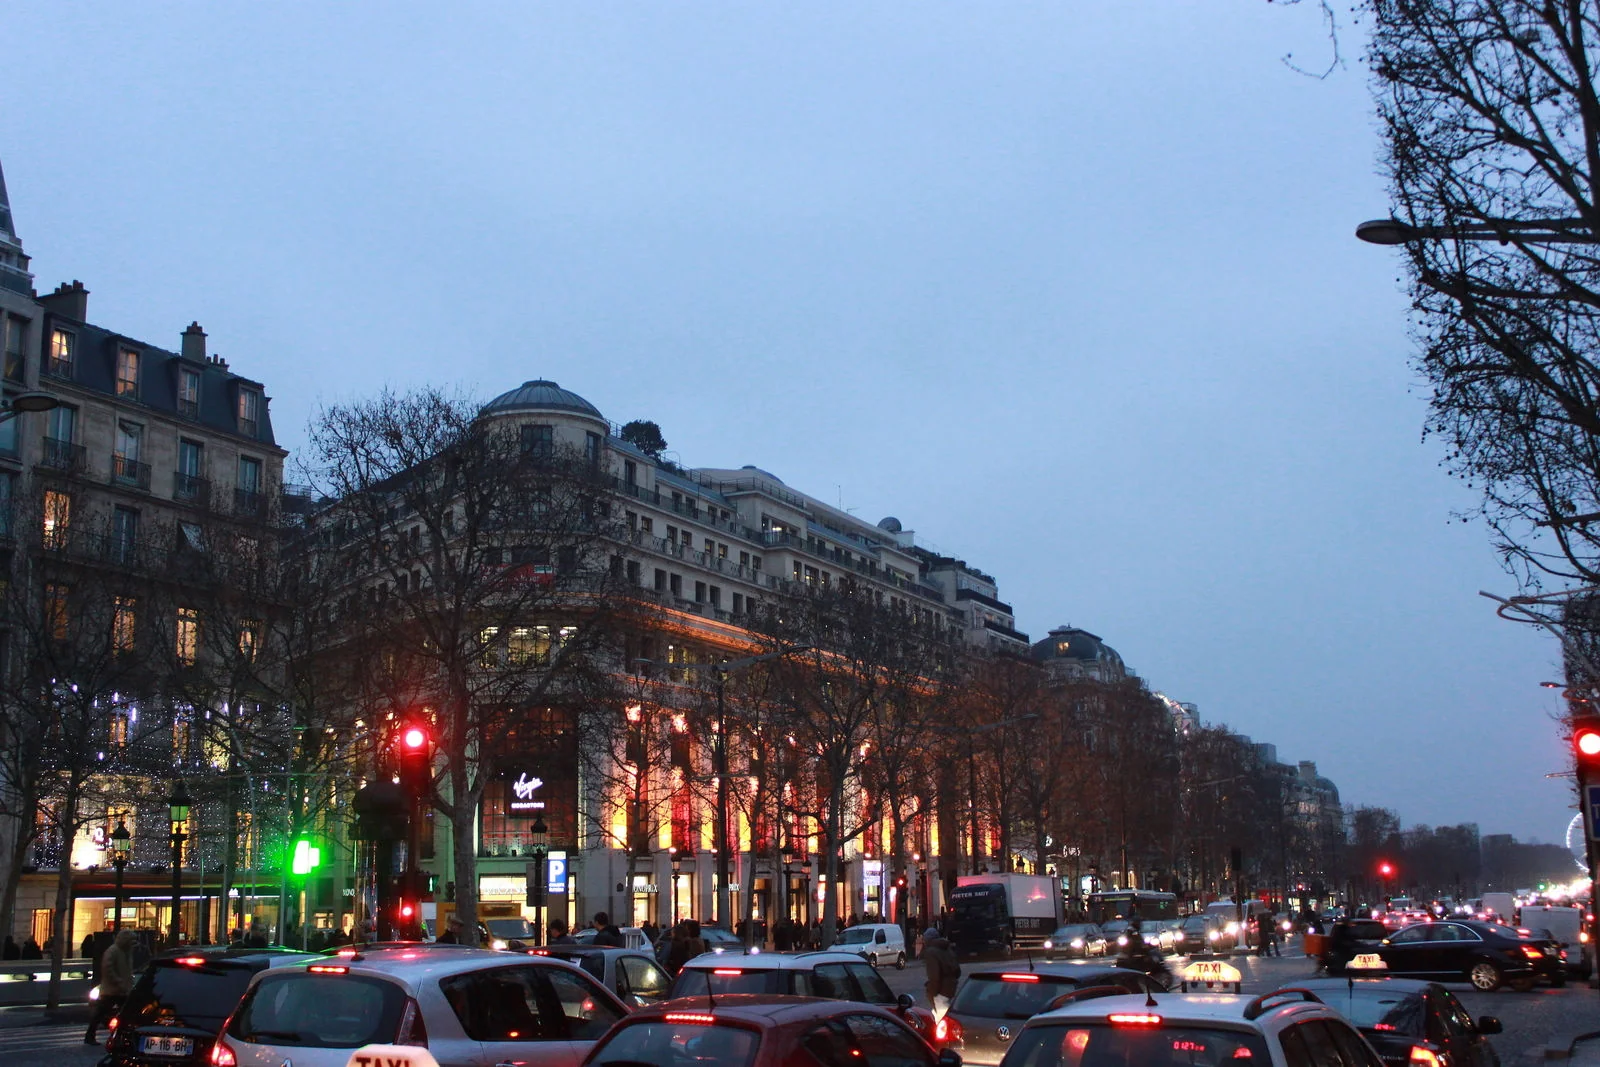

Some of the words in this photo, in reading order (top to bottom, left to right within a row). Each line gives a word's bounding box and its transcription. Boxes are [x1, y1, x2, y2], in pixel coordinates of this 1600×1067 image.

[513, 772, 542, 799] Virgin
[550, 861, 564, 882] P
[633, 884, 658, 893] ONOPRIX
[1358, 955, 1374, 963] TAXI
[1196, 963, 1221, 973] TAXI
[356, 1056, 409, 1067] TAXI
